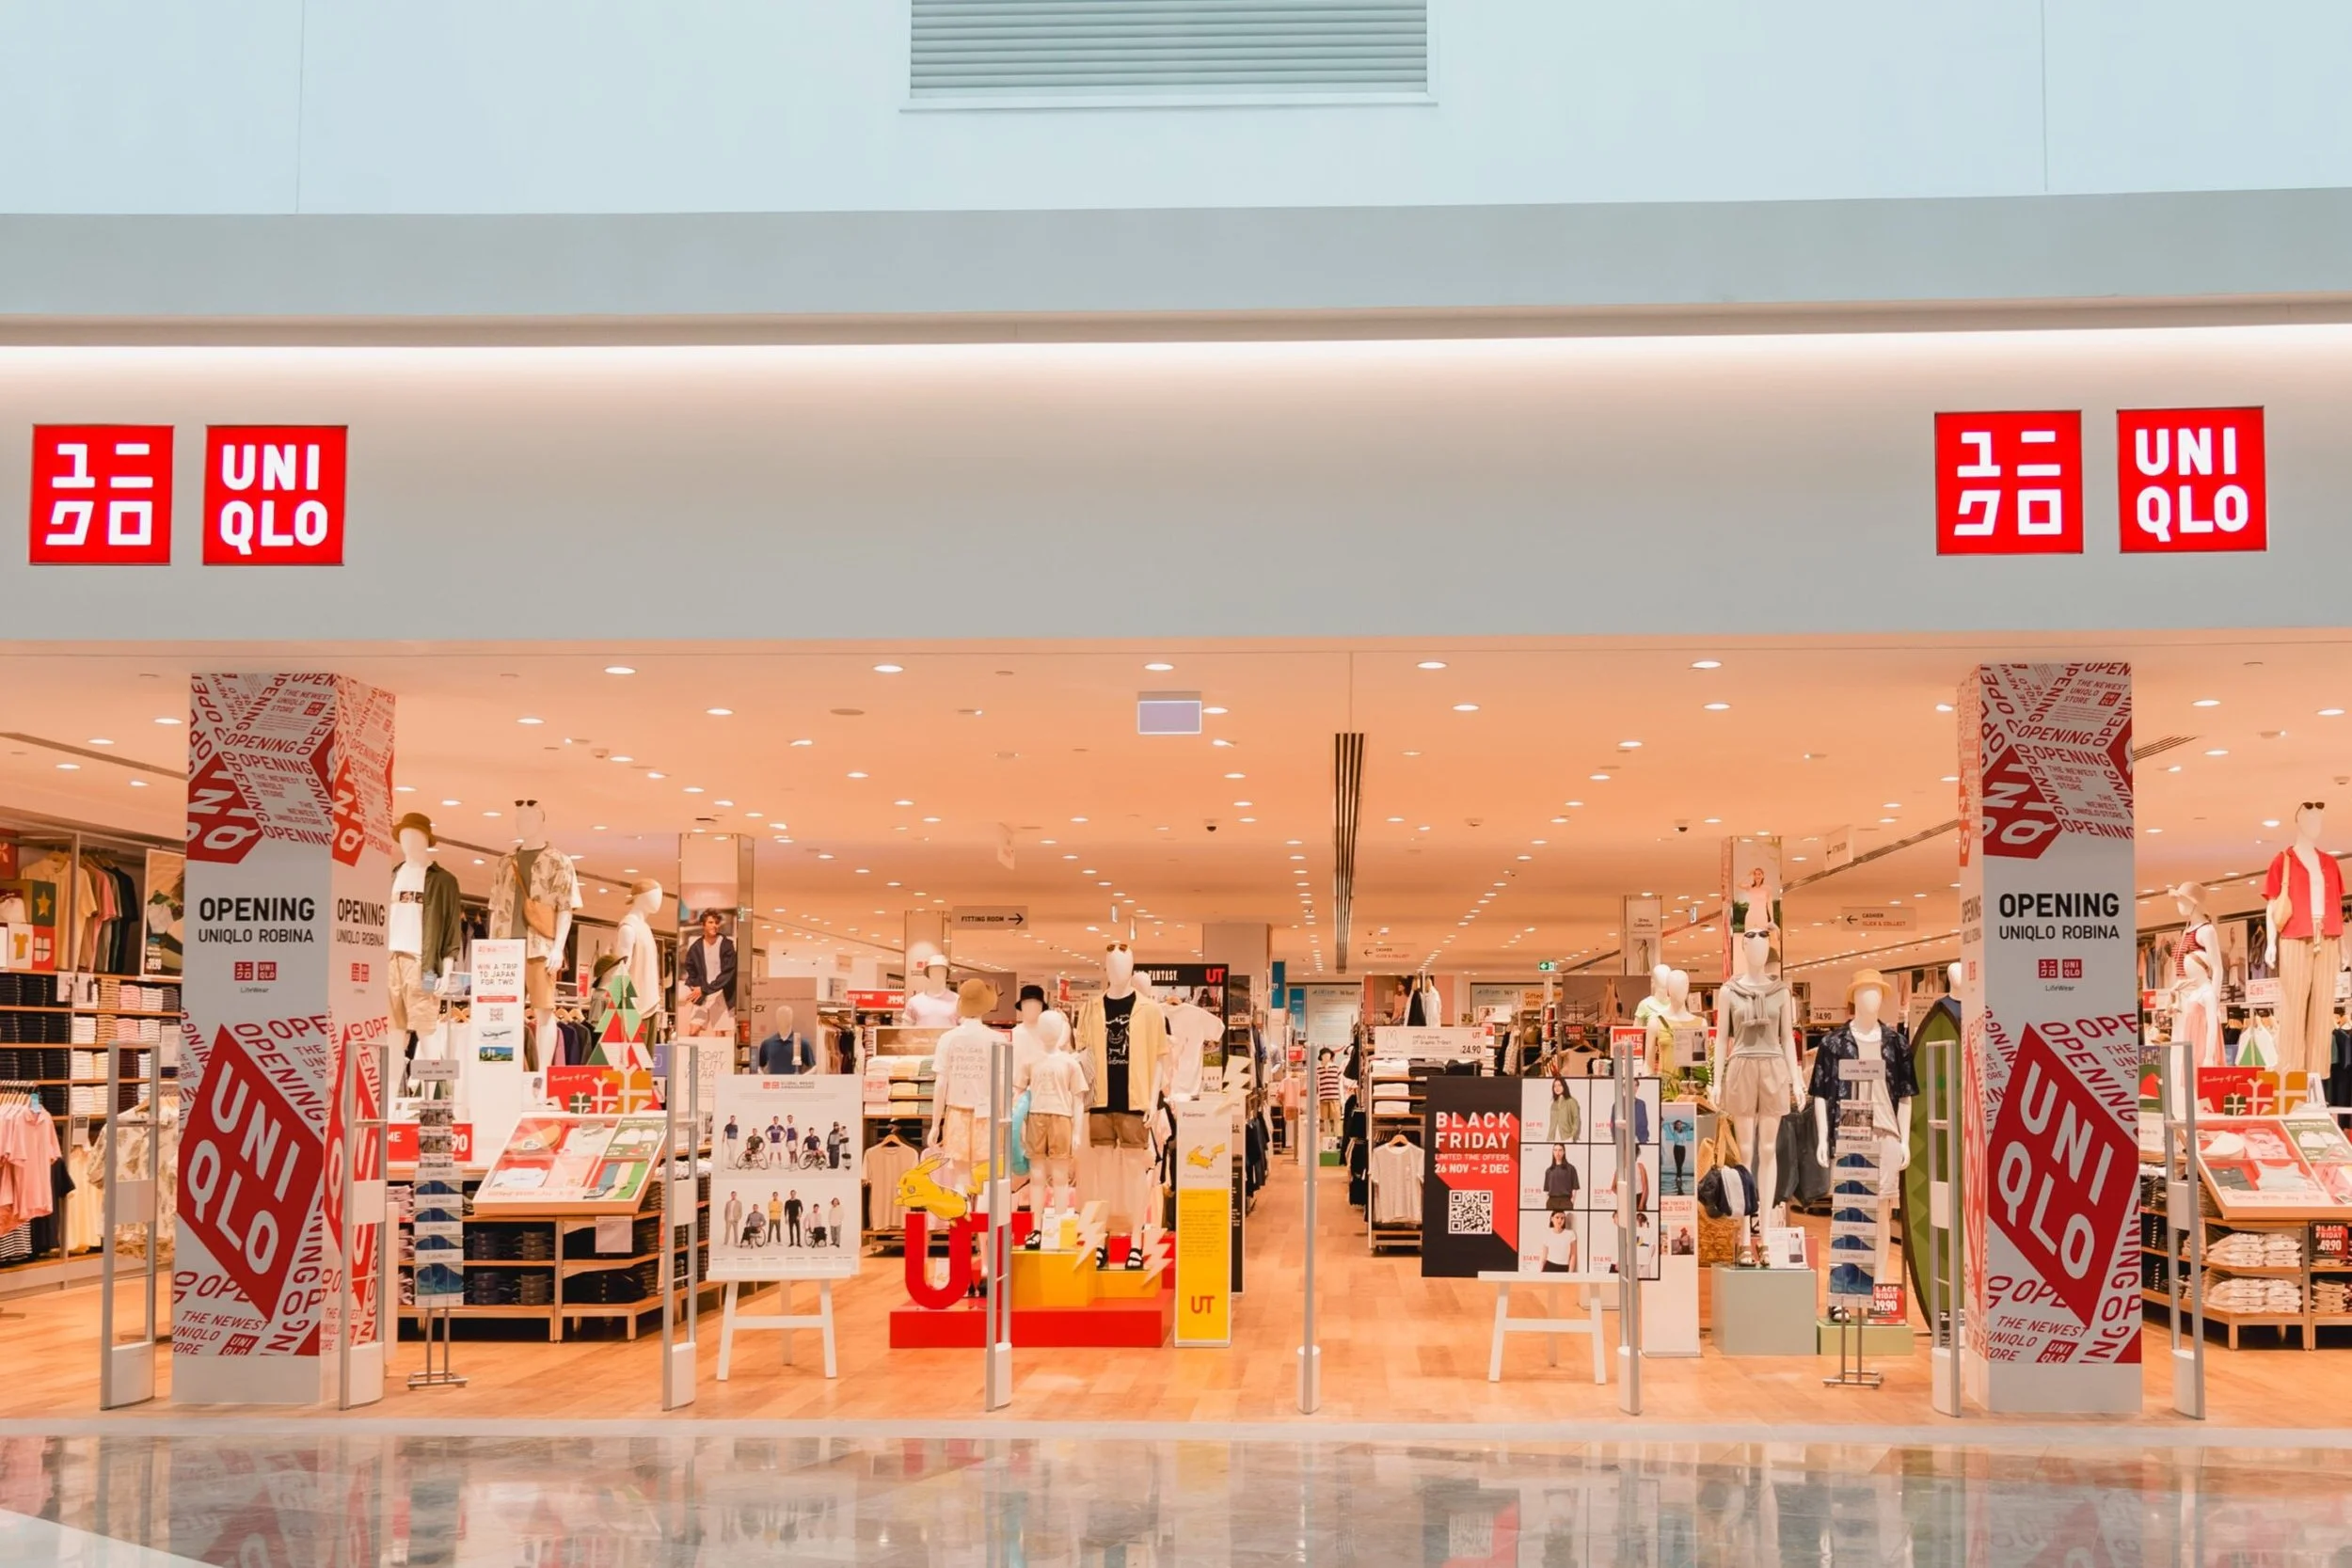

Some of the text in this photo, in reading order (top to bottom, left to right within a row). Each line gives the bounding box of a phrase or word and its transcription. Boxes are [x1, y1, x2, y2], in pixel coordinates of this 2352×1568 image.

[2135, 427, 2237, 476] UNI
[221, 443, 320, 490] UNI
[2137, 484, 2249, 543] QLO
[219, 499, 328, 555] QLO
[283, 689, 301, 697] THE
[2028, 663, 2083, 722] PENING
[2076, 678, 2128, 691] THE NEWEST
[236, 673, 292, 731] PENING
[224, 733, 297, 753] OPENING
[2017, 725, 2094, 745] OPENING
[239, 753, 313, 775] OPENING
[2033, 745, 2111, 768] OPENING
[221, 751, 271, 822] OPENING
[2014, 744, 2070, 816] OPENING
[199, 896, 316, 923] OPENING
[337, 897, 386, 927] OPENING
[1998, 893, 2121, 919] OPENING
[198, 927, 315, 944] UNIQLO ROBINA
[1998, 925, 2056, 942] UNIQLO
[2061, 925, 2121, 940] ROBINA
[1205, 968, 1225, 984] UT
[294, 1045, 326, 1056] THE
[2103, 1043, 2137, 1054] THE
[234, 1022, 323, 1123] OPENING
[2040, 1022, 2138, 1123] OPENING
[211, 1060, 301, 1203] UNI
[1435, 1111, 1510, 1129] BLACK
[1435, 1132, 1510, 1148] FRIDAY
[2020, 1059, 2115, 1207] UNI
[1435, 1163, 1510, 1174] 26 NOV 2 DEC
[187, 1139, 279, 1275] QLO
[1997, 1140, 2095, 1280] QLO
[1190, 1295, 1216, 1314] UT
[182, 1310, 270, 1333] THE NEWEST
[1995, 1315, 2090, 1338] THE NEWEST
